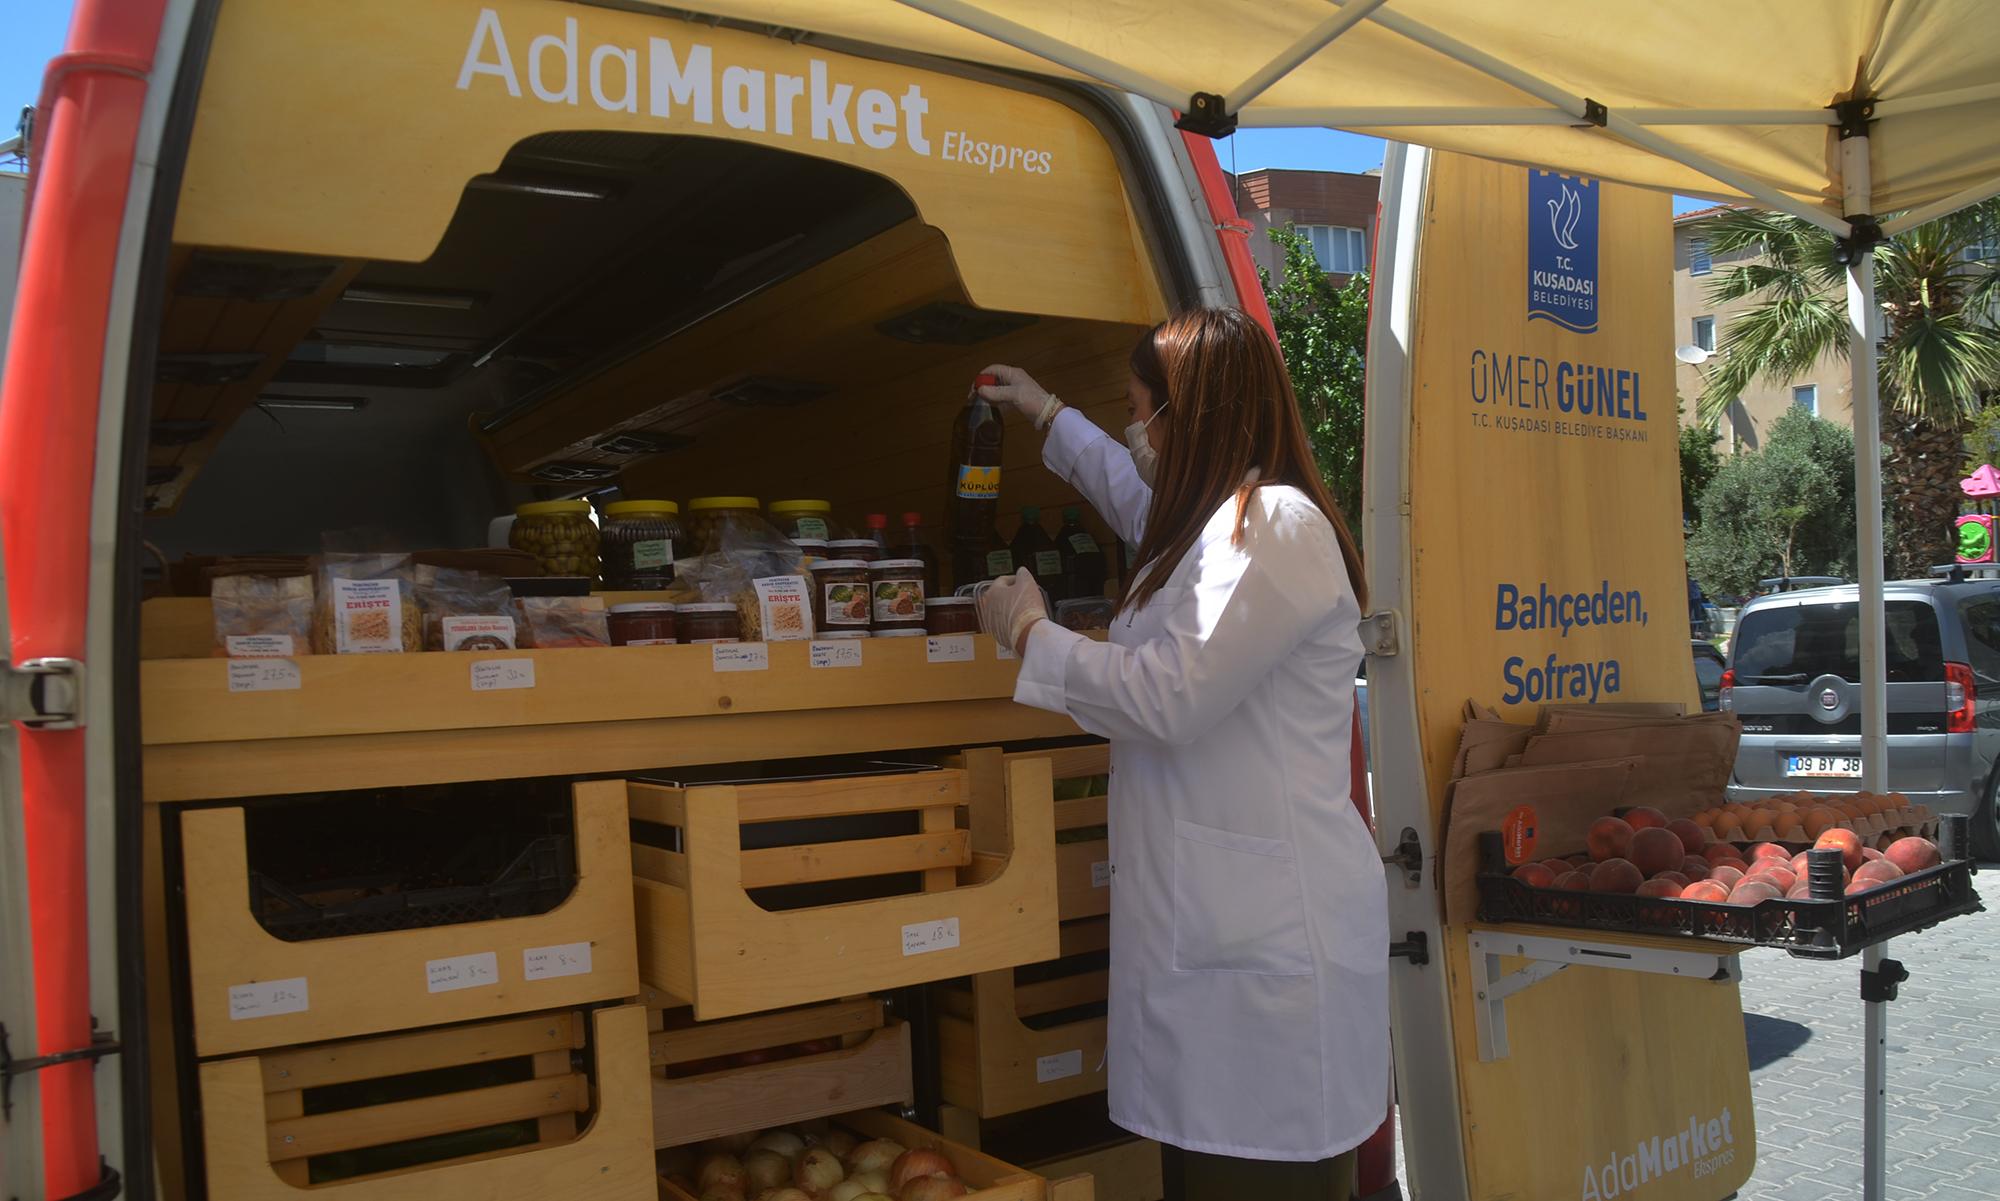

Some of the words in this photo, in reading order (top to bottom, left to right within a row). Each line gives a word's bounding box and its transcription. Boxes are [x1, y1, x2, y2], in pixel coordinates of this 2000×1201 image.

[455, 7, 931, 156] AdaMarket
[941, 131, 1052, 175] Ekspres
[1556, 255, 1574, 271] T.C.
[1533, 270, 1594, 296] KUŞADASI
[1533, 290, 1594, 311] BELEDİYESİ
[1556, 361, 1647, 421] GÜNEL
[1471, 412, 1492, 429] T.C.
[1496, 415, 1551, 433] KUŞADASI
[1554, 421, 1603, 439] BELEDİYE
[1606, 426, 1648, 442] BAŞKANI
[767, 594, 801, 605] ERİŞTE
[1495, 580, 1648, 638] Bahçeden,
[1501, 653, 1621, 706] Sofraya
[1796, 757, 1812, 771] 09
[1819, 757, 1836, 771] BY
[1582, 1106, 1734, 1201] AdaMarket
